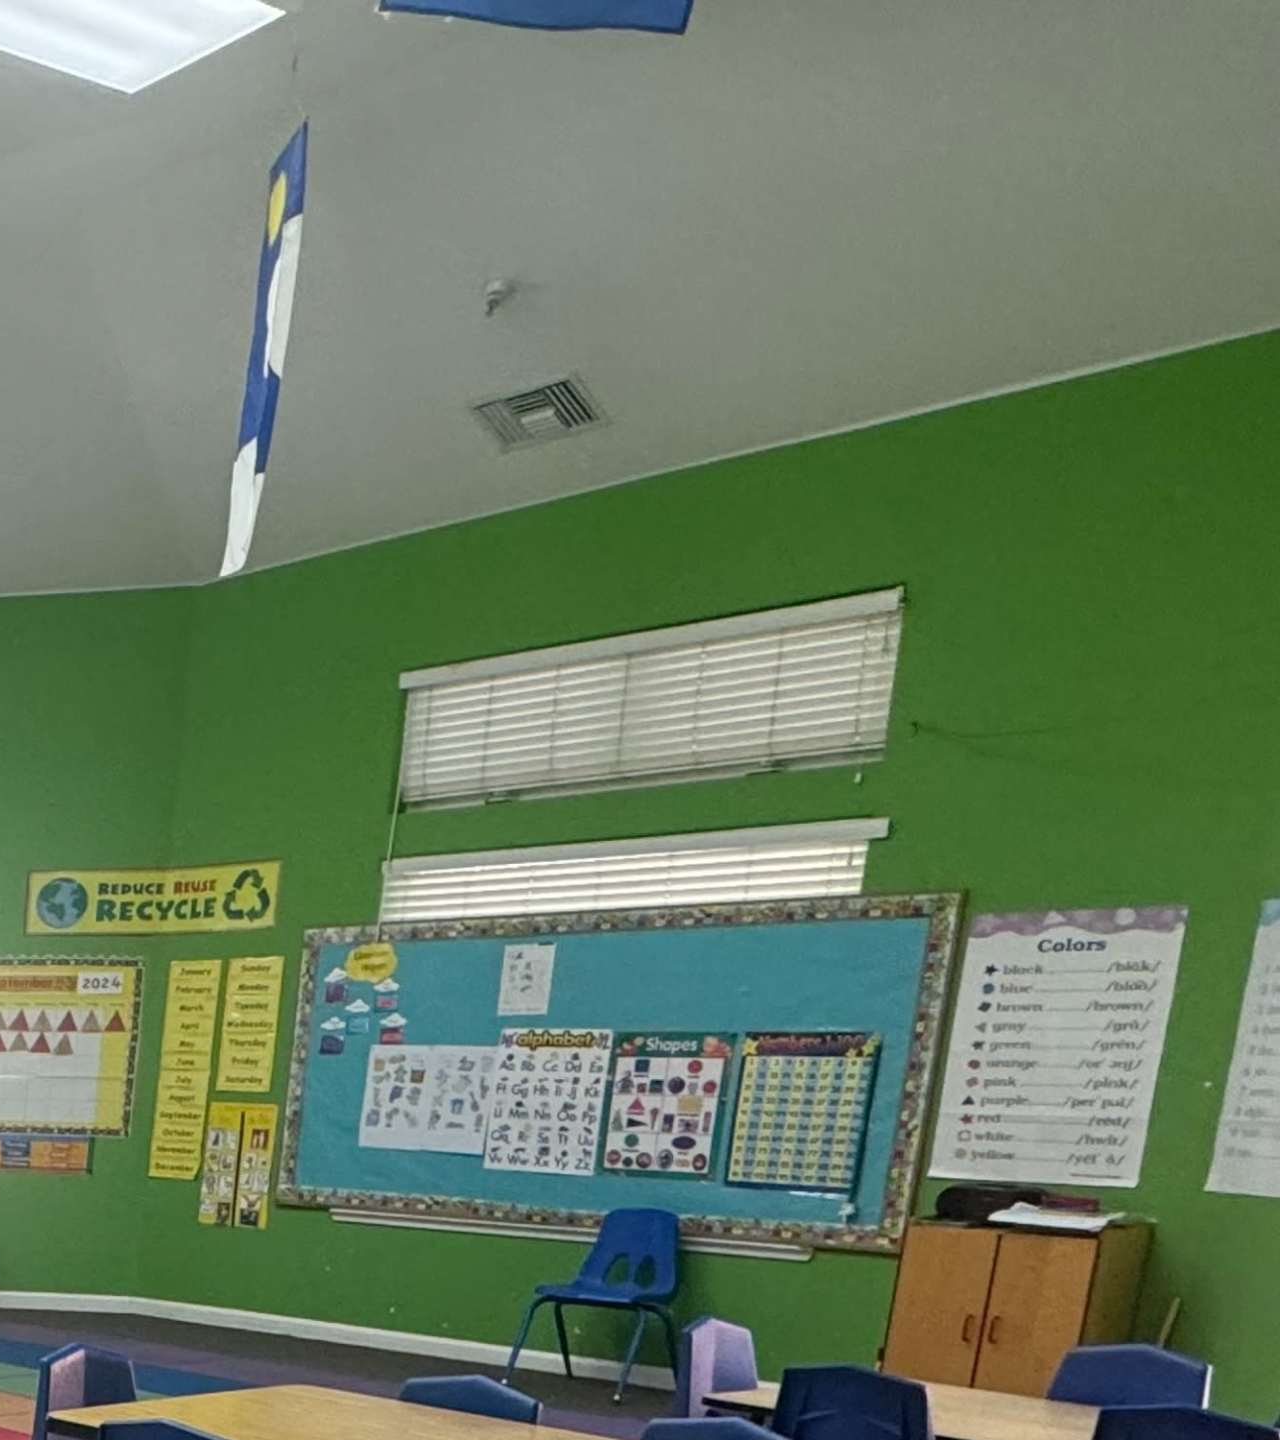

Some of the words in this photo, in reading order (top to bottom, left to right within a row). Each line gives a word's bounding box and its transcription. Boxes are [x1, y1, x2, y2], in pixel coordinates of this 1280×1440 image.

[97, 882, 165, 895] REDUCE
[173, 879, 216, 893] REUSE
[95, 897, 216, 922] RECYCLE
[1037, 938, 1107, 953] Colors
[1003, 963, 1044, 975] black
[81, 977, 122, 990] 2024
[1000, 983, 1033, 994] blue
[517, 1029, 593, 1051] alphabet
[645, 1037, 698, 1053] Shapes
[977, 1114, 1002, 1123] red
